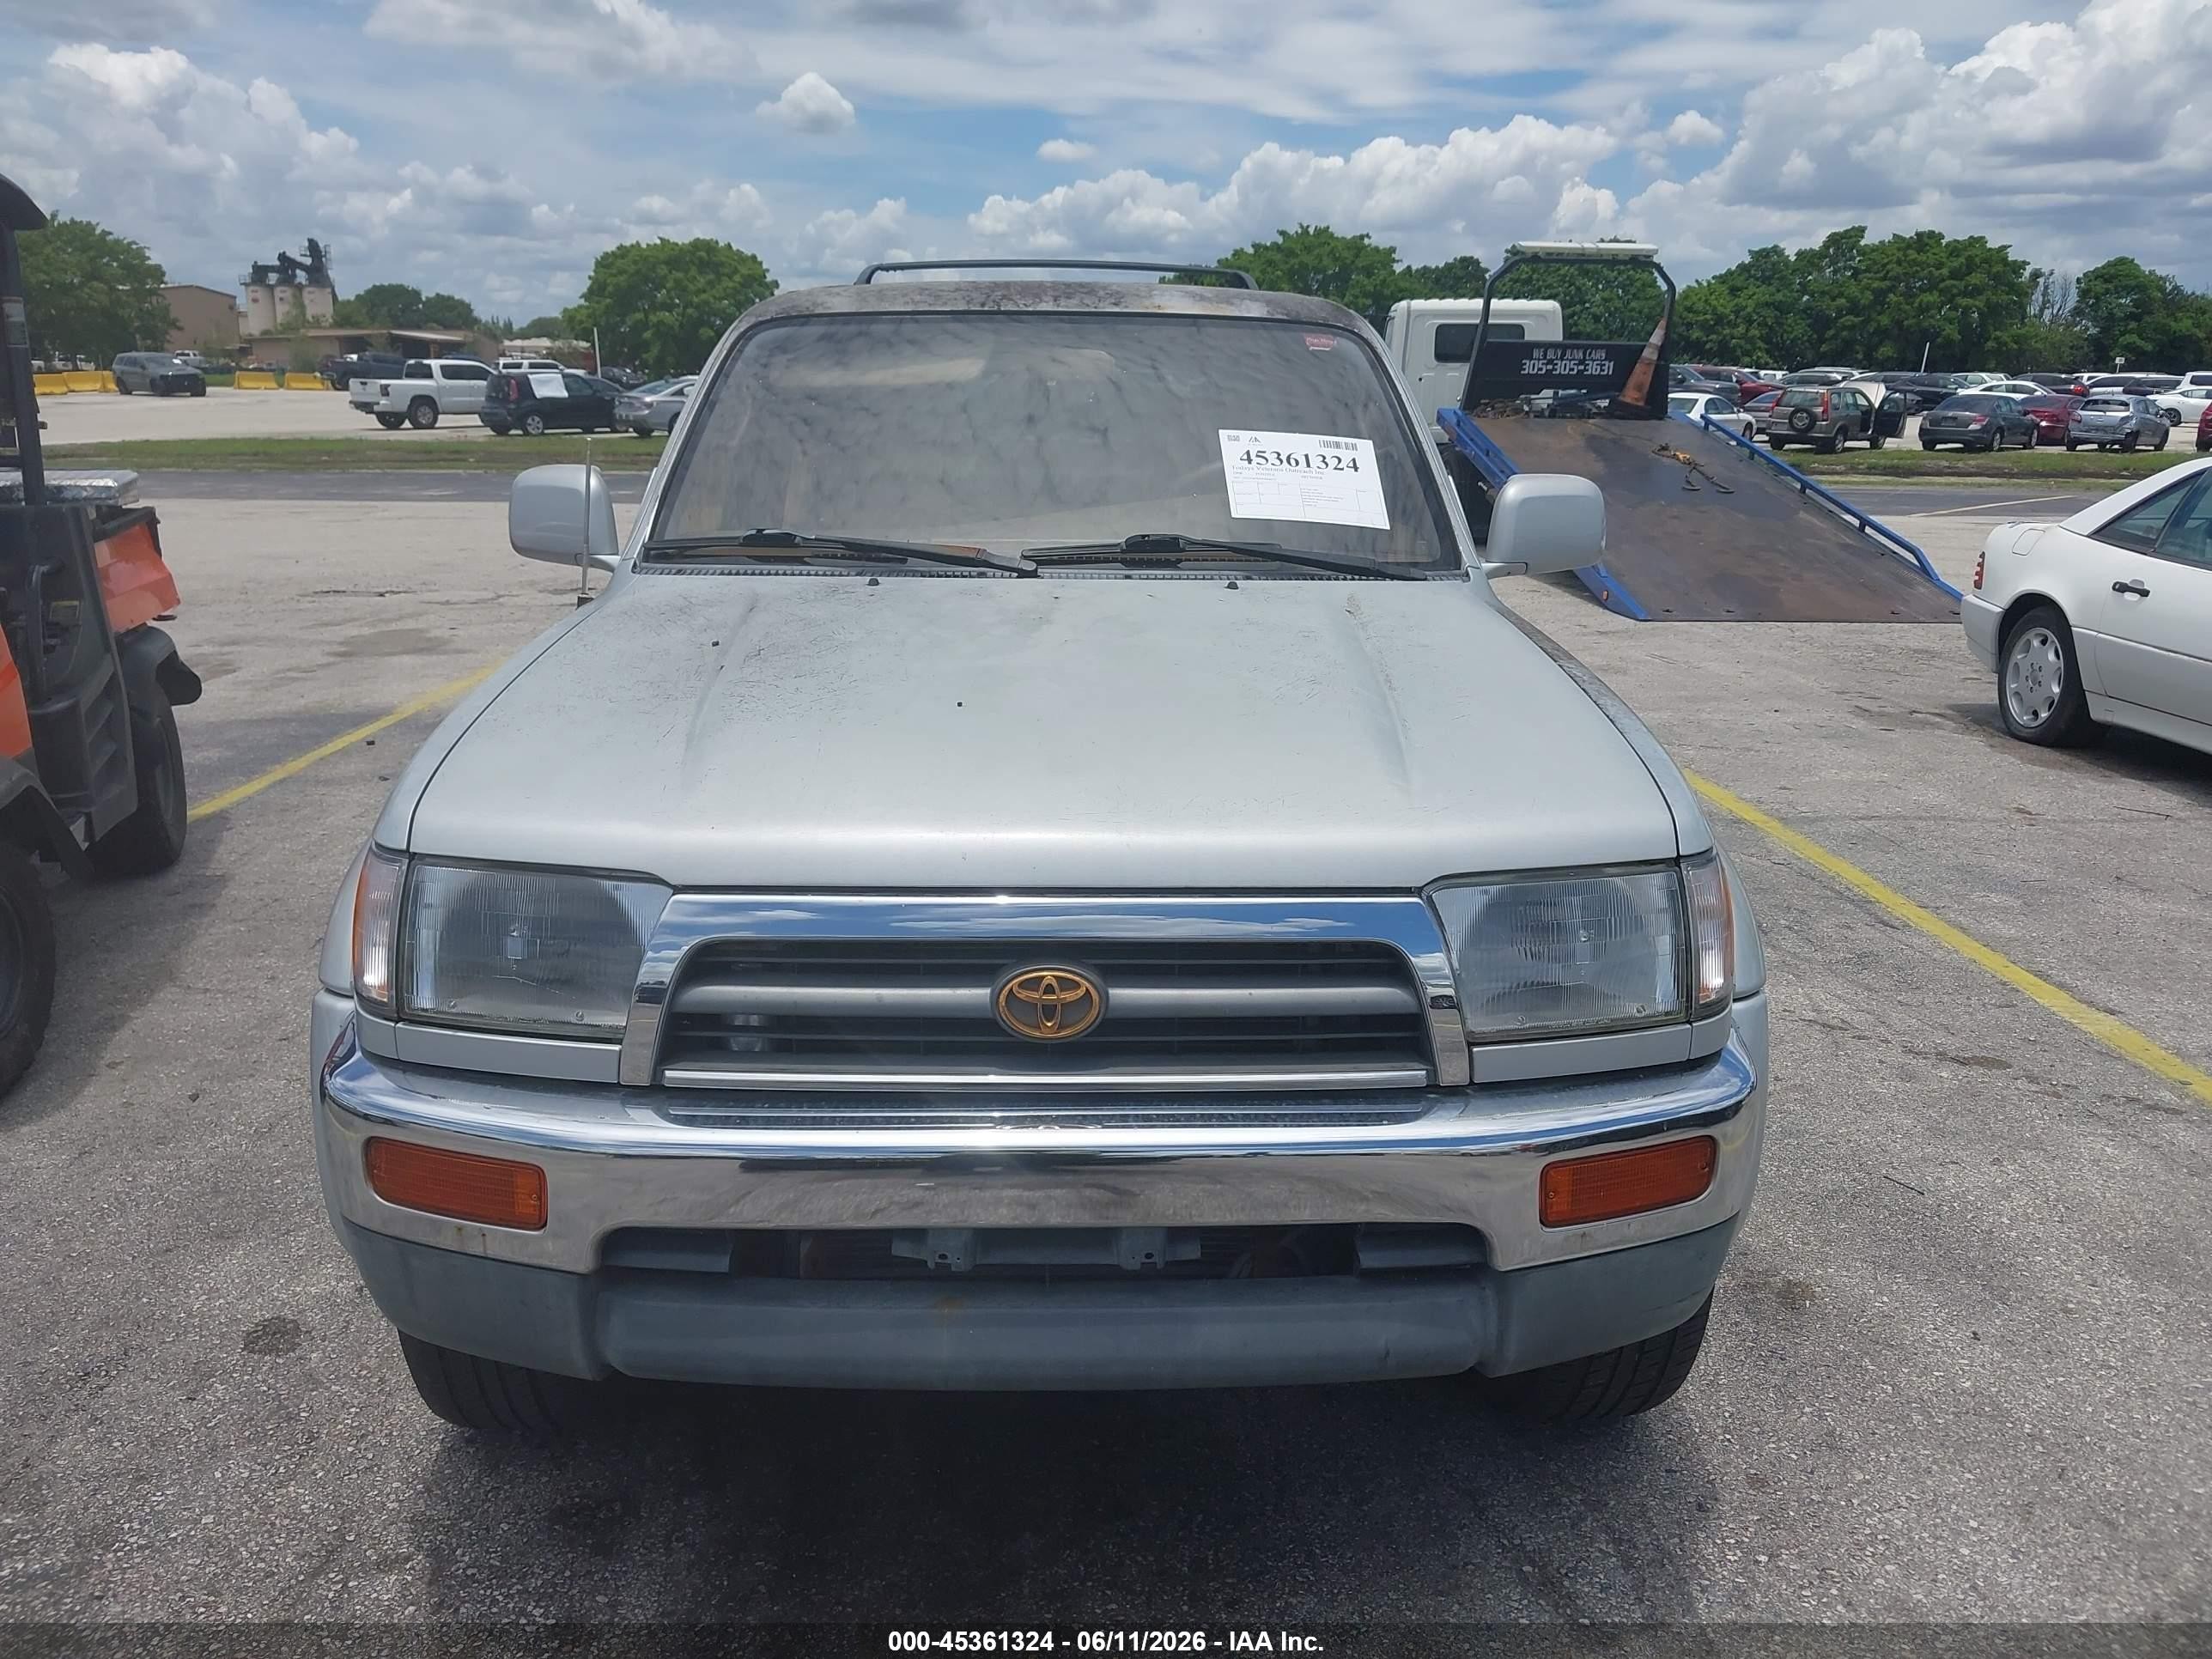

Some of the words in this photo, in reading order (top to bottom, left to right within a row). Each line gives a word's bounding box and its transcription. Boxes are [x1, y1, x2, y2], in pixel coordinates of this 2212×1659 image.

[1533, 349, 1544, 359] WE
[1547, 349, 1562, 359] BUY
[1564, 349, 1584, 360] JUNK
[1586, 349, 1606, 360] CARS
[1521, 360, 1614, 375] 305-305-3631
[1239, 449, 1360, 472] 45361324
